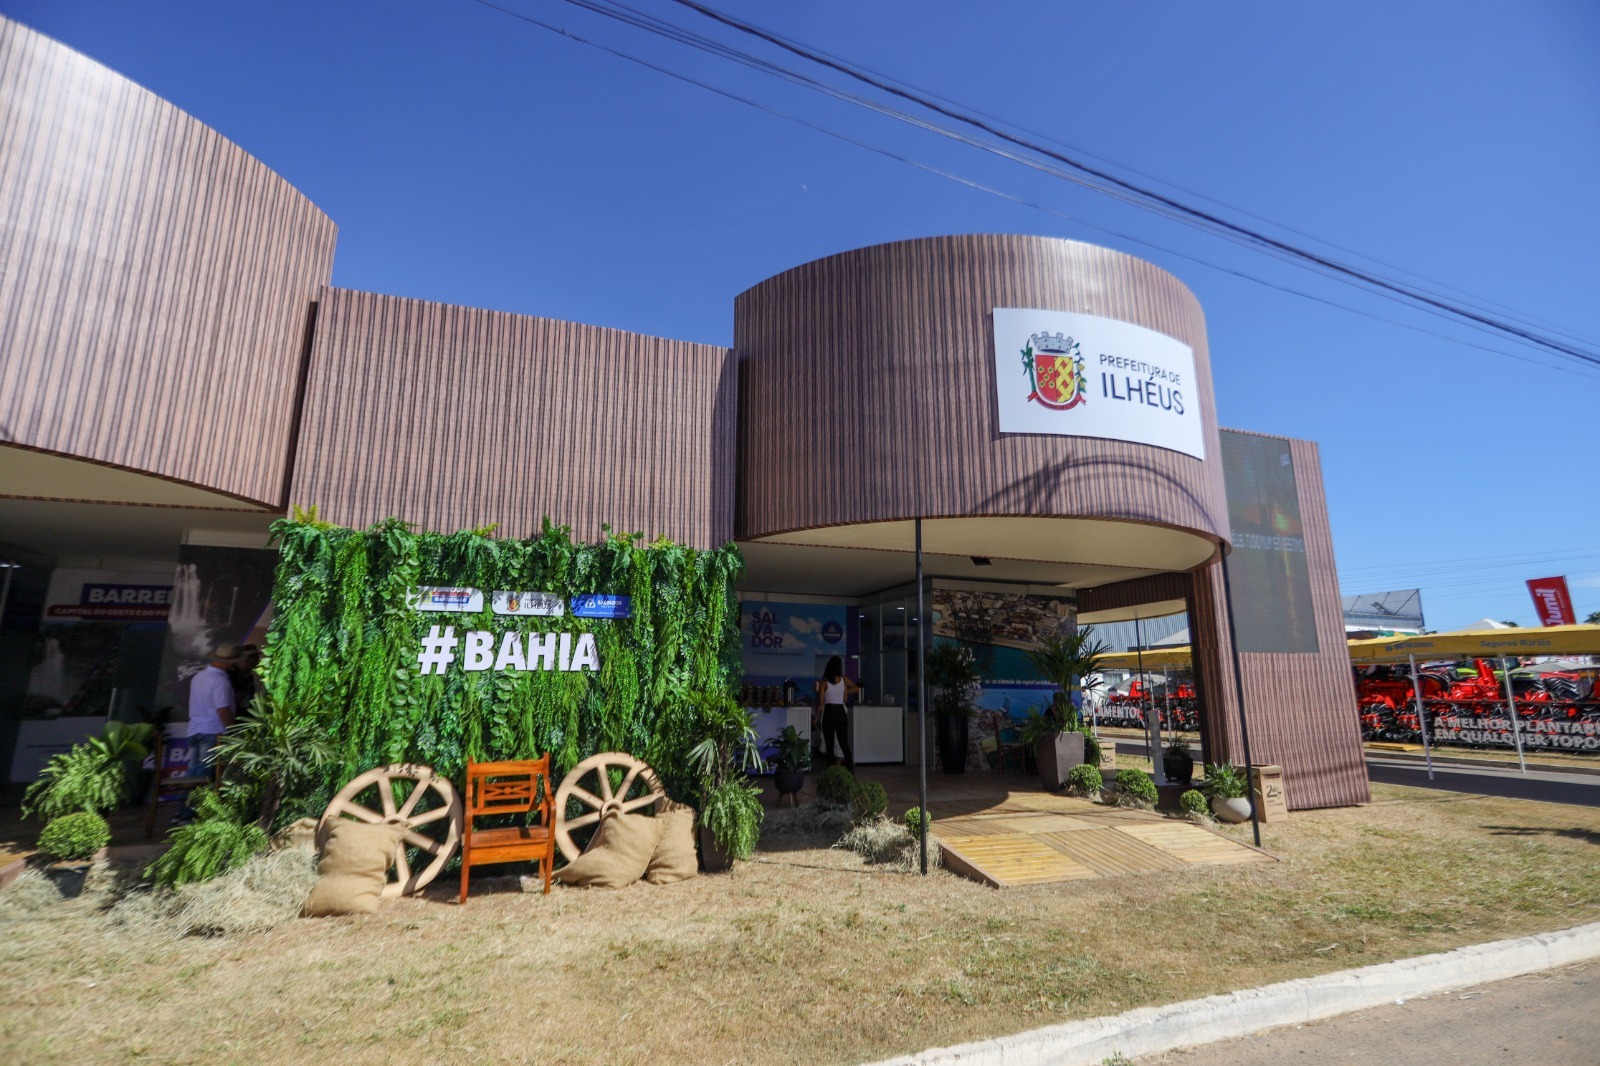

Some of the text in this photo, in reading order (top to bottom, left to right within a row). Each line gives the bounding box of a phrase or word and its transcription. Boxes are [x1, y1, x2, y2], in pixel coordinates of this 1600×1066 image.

[1099, 353, 1182, 385] PREFEITURA DE
[1101, 372, 1185, 416] ILHÉUS
[751, 611, 779, 625] SAL
[751, 623, 774, 636] VA
[751, 636, 783, 649] DOR
[1480, 638, 1551, 649] Seguros Rurais
[417, 624, 601, 676] #BAHIA
[997, 677, 1015, 685] cidade
[1434, 716, 1445, 728] A
[1447, 717, 1513, 731] MELHOR
[1434, 728, 1457, 741] EM
